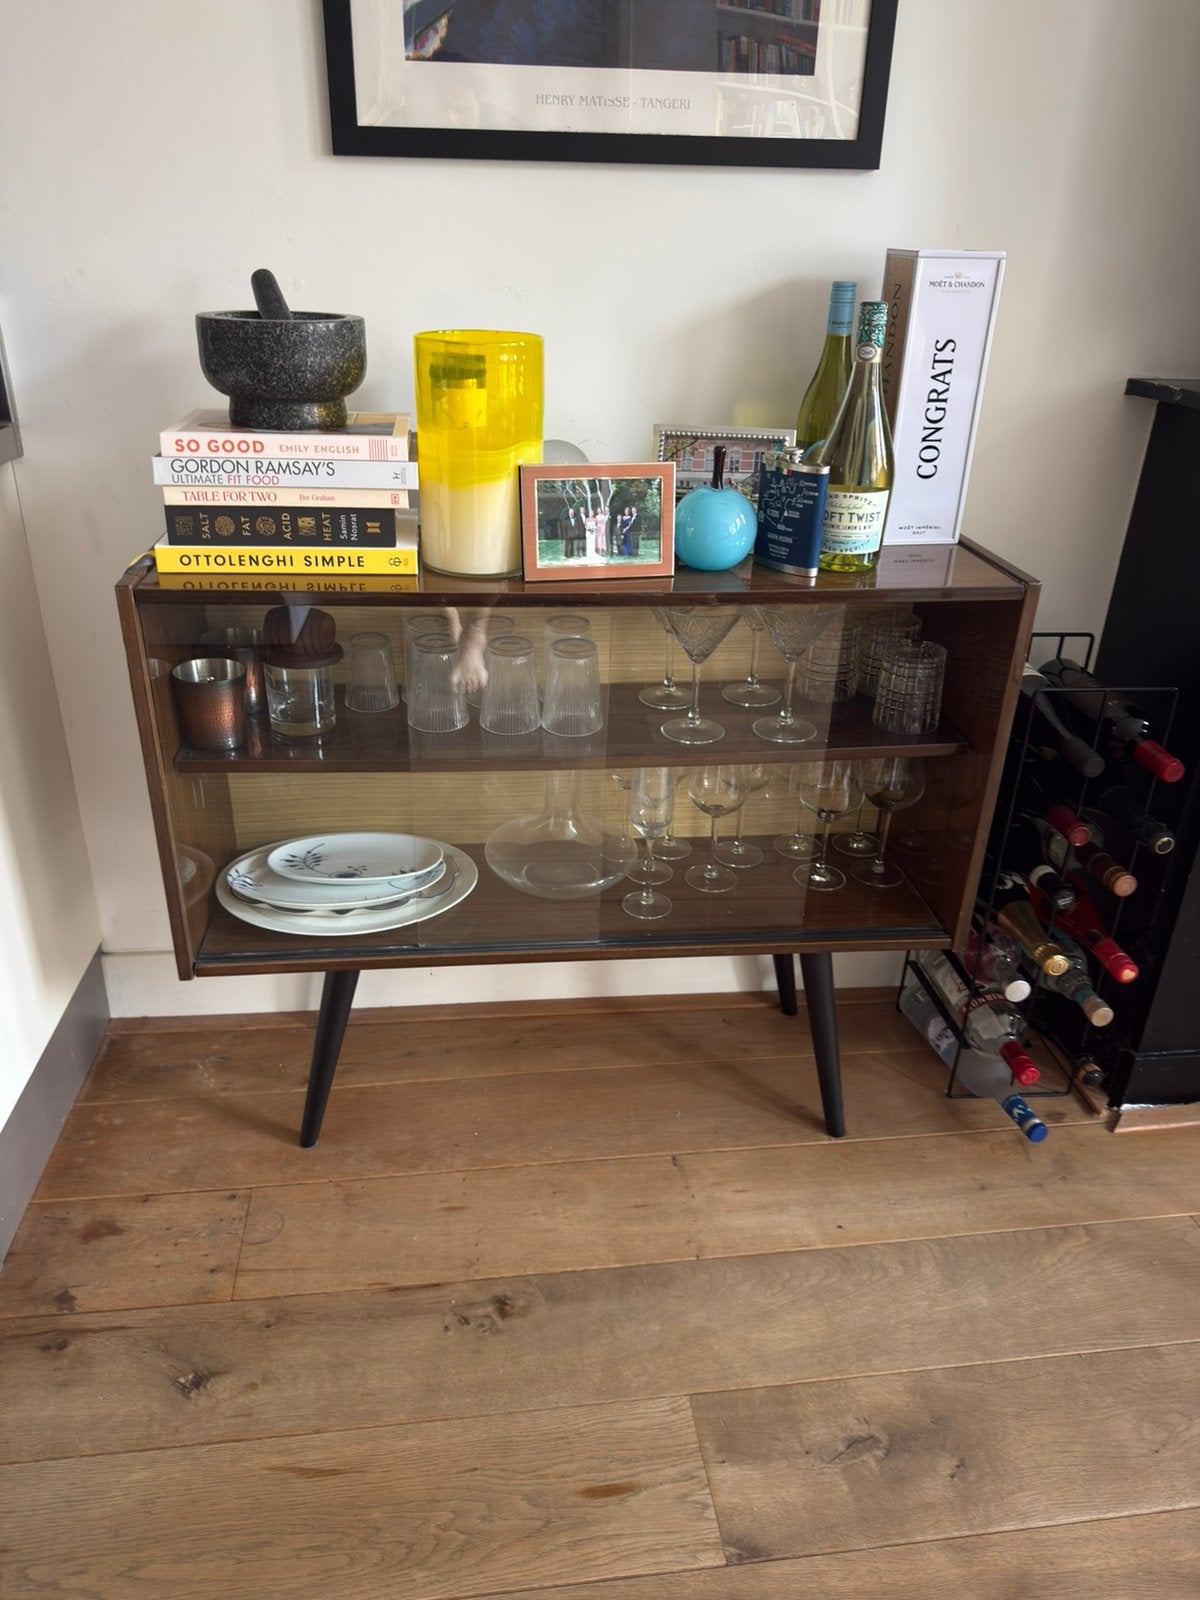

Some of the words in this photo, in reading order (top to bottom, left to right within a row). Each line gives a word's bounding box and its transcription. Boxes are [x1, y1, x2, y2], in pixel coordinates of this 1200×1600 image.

[536, 94, 576, 106] HENRY
[640, 97, 691, 109] TANGERI
[883, 283, 902, 394] HANDON
[916, 338, 957, 480] CONGRATS
[175, 438, 200, 453] SO
[207, 439, 265, 454] GOOD
[279, 444, 310, 453] EMILY
[314, 445, 360, 455] ENGLISH
[170, 458, 250, 474] GORDON
[255, 460, 336, 476] RAMSAY'S
[171, 474, 224, 484] ULTIMATE
[226, 475, 242, 484] FIT
[246, 475, 280, 486] FOOD
[181, 490, 220, 502] TABLE
[222, 491, 247, 502] FOR
[248, 491, 278, 502] TWO
[199, 512, 211, 540] SALT
[241, 515, 252, 537] FAT
[281, 512, 293, 541] ACID
[824, 510, 845, 523] OFT
[847, 511, 881, 523] TWIST
[322, 512, 333, 542] HEAT
[340, 514, 348, 540] Samin
[350, 513, 359, 541] Nosrat
[179, 553, 294, 567] OTTOLENGHI
[303, 555, 365, 568] SIMPLE
[963, 992, 1006, 1012] MIRNO
